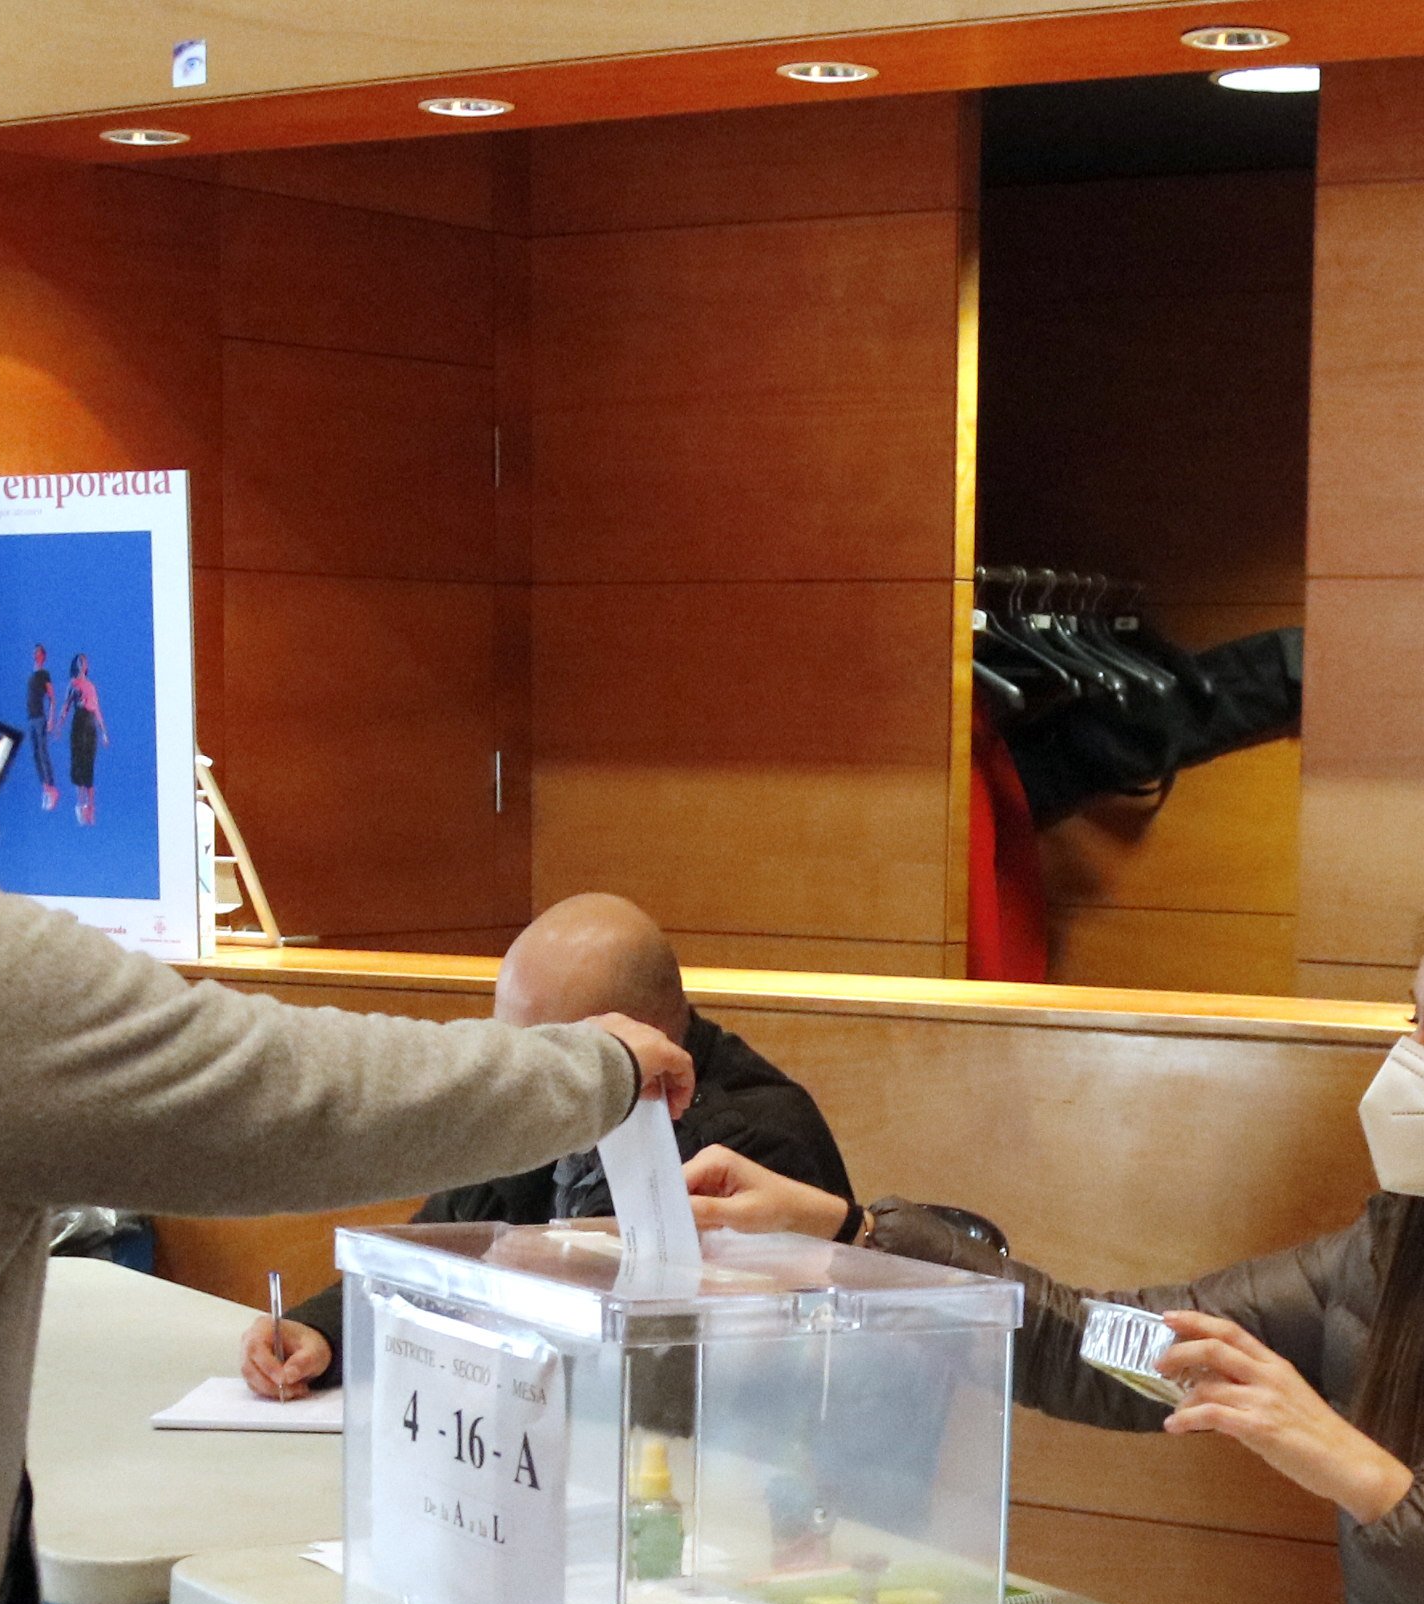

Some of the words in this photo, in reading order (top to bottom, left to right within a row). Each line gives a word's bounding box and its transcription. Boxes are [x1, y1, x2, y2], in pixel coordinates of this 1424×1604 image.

[384, 1335, 436, 1369] DISTRICTE
[452, 1357, 491, 1387] SECCIÓ
[512, 1377, 548, 1406] MESA
[403, 1389, 419, 1442] 4
[514, 1431, 541, 1491] A
[423, 1496, 437, 1517] De
[453, 1500, 464, 1528] A
[493, 1514, 506, 1544] L
